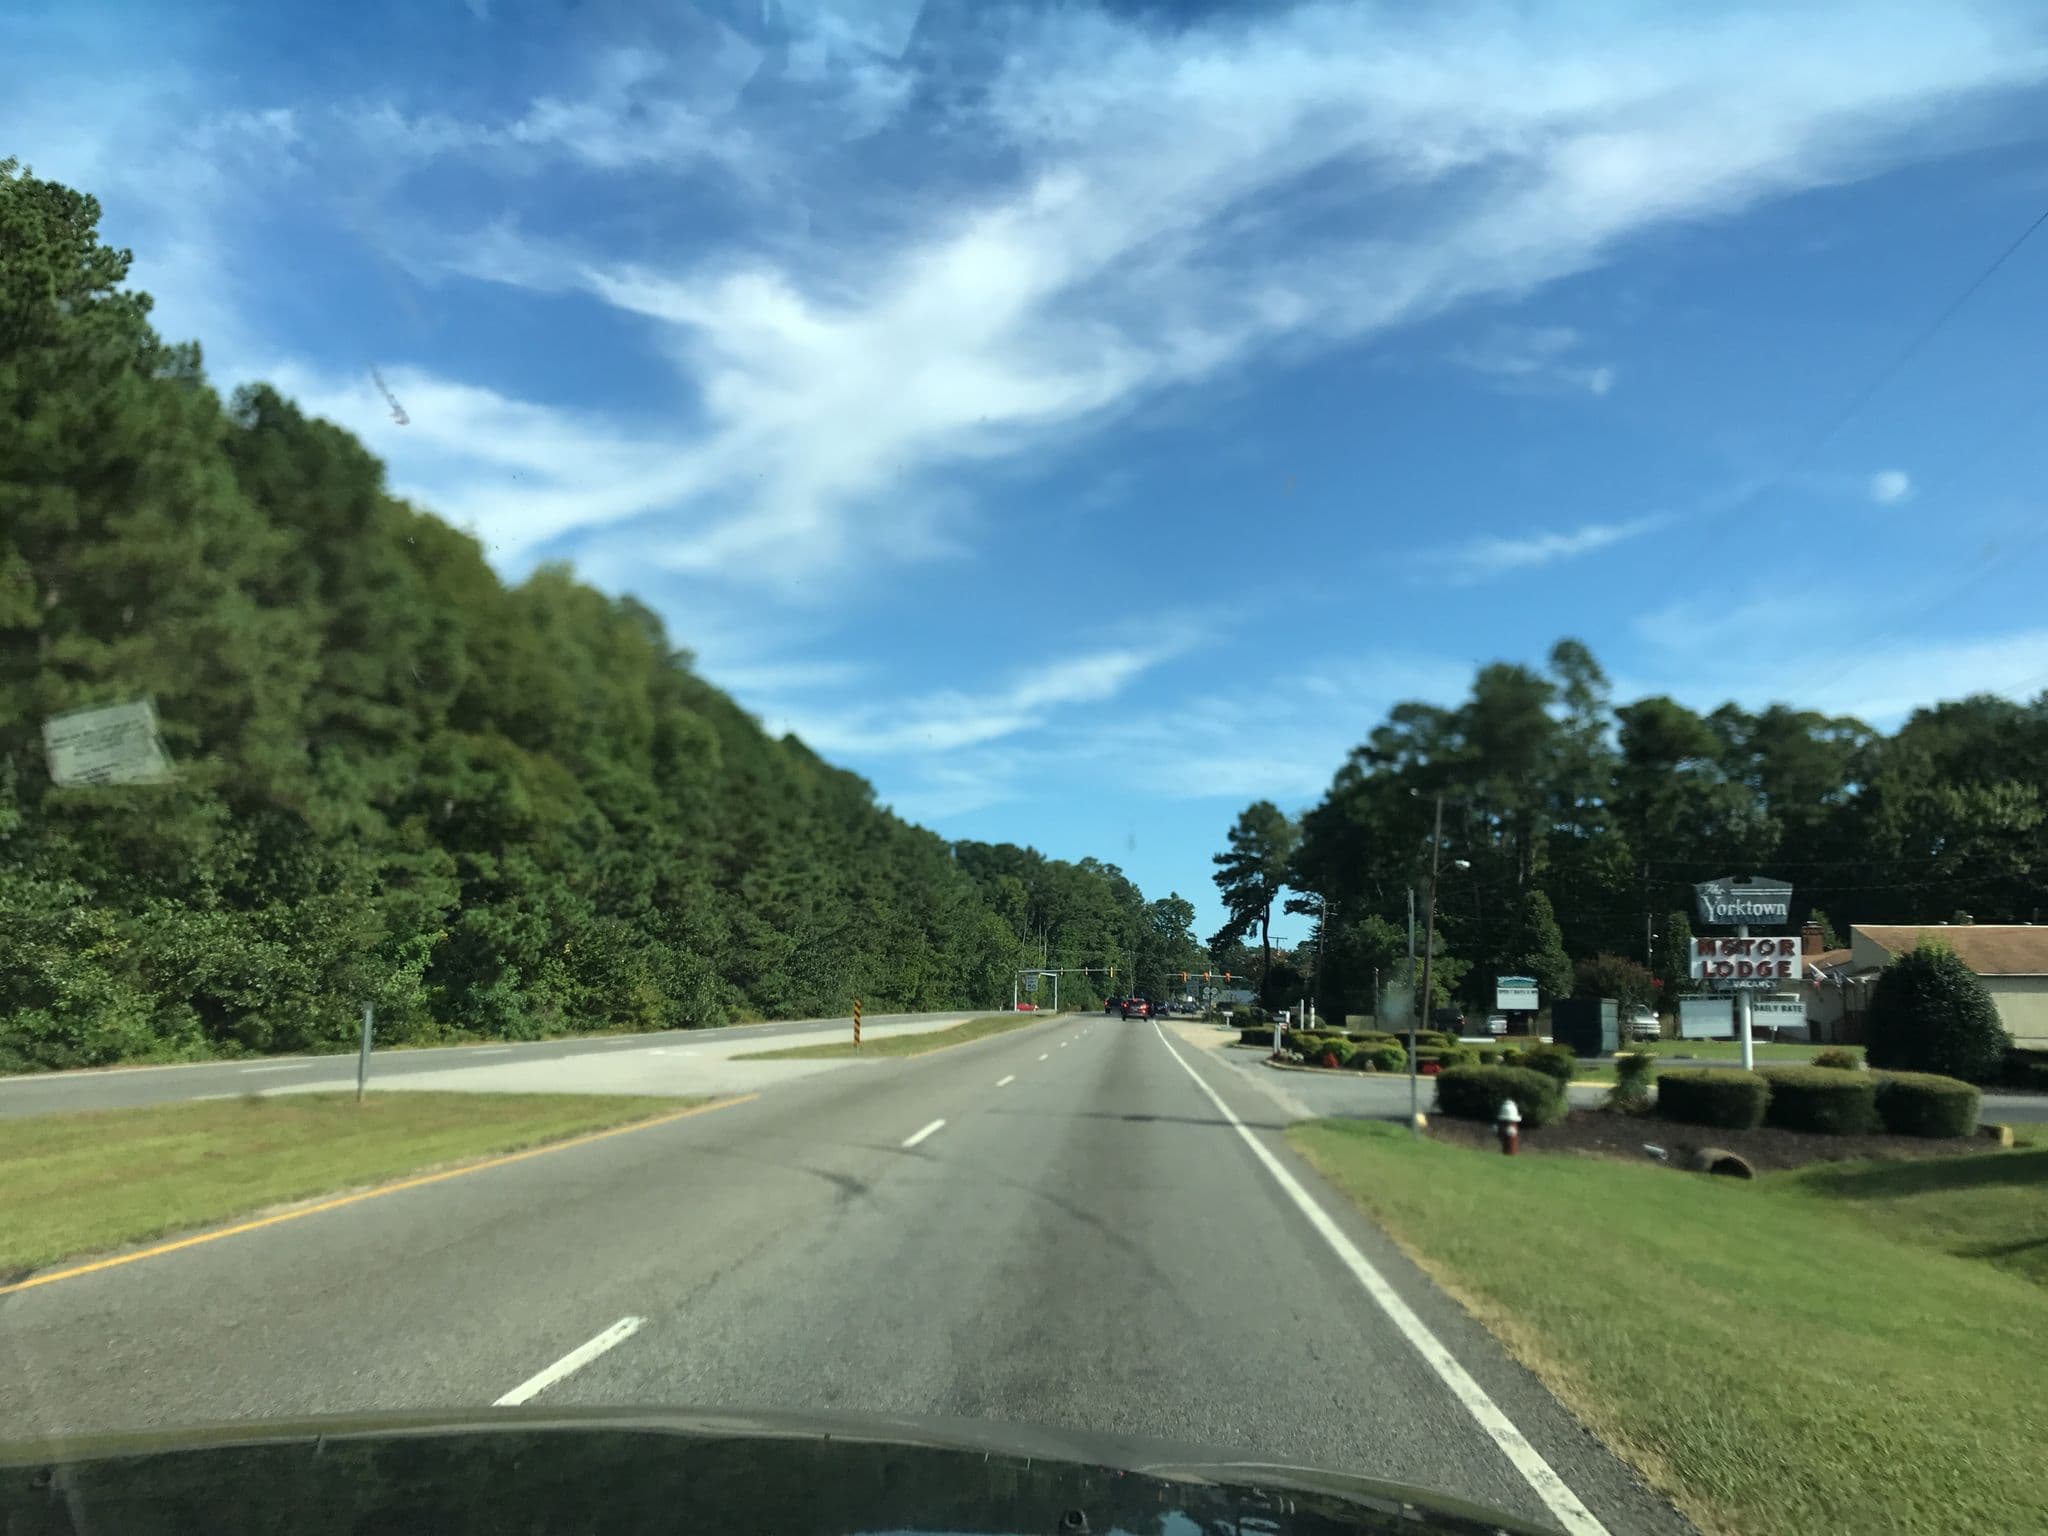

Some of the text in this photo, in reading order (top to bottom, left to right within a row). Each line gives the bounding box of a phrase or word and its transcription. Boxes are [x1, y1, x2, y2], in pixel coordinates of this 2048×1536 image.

[1701, 896, 1787, 922] Yorktown
[1698, 939, 1796, 957] MOTOR
[1702, 961, 1793, 978] LODGE
[1733, 980, 1777, 989] VACANCY
[1754, 1004, 1803, 1013] DAILY RATE
